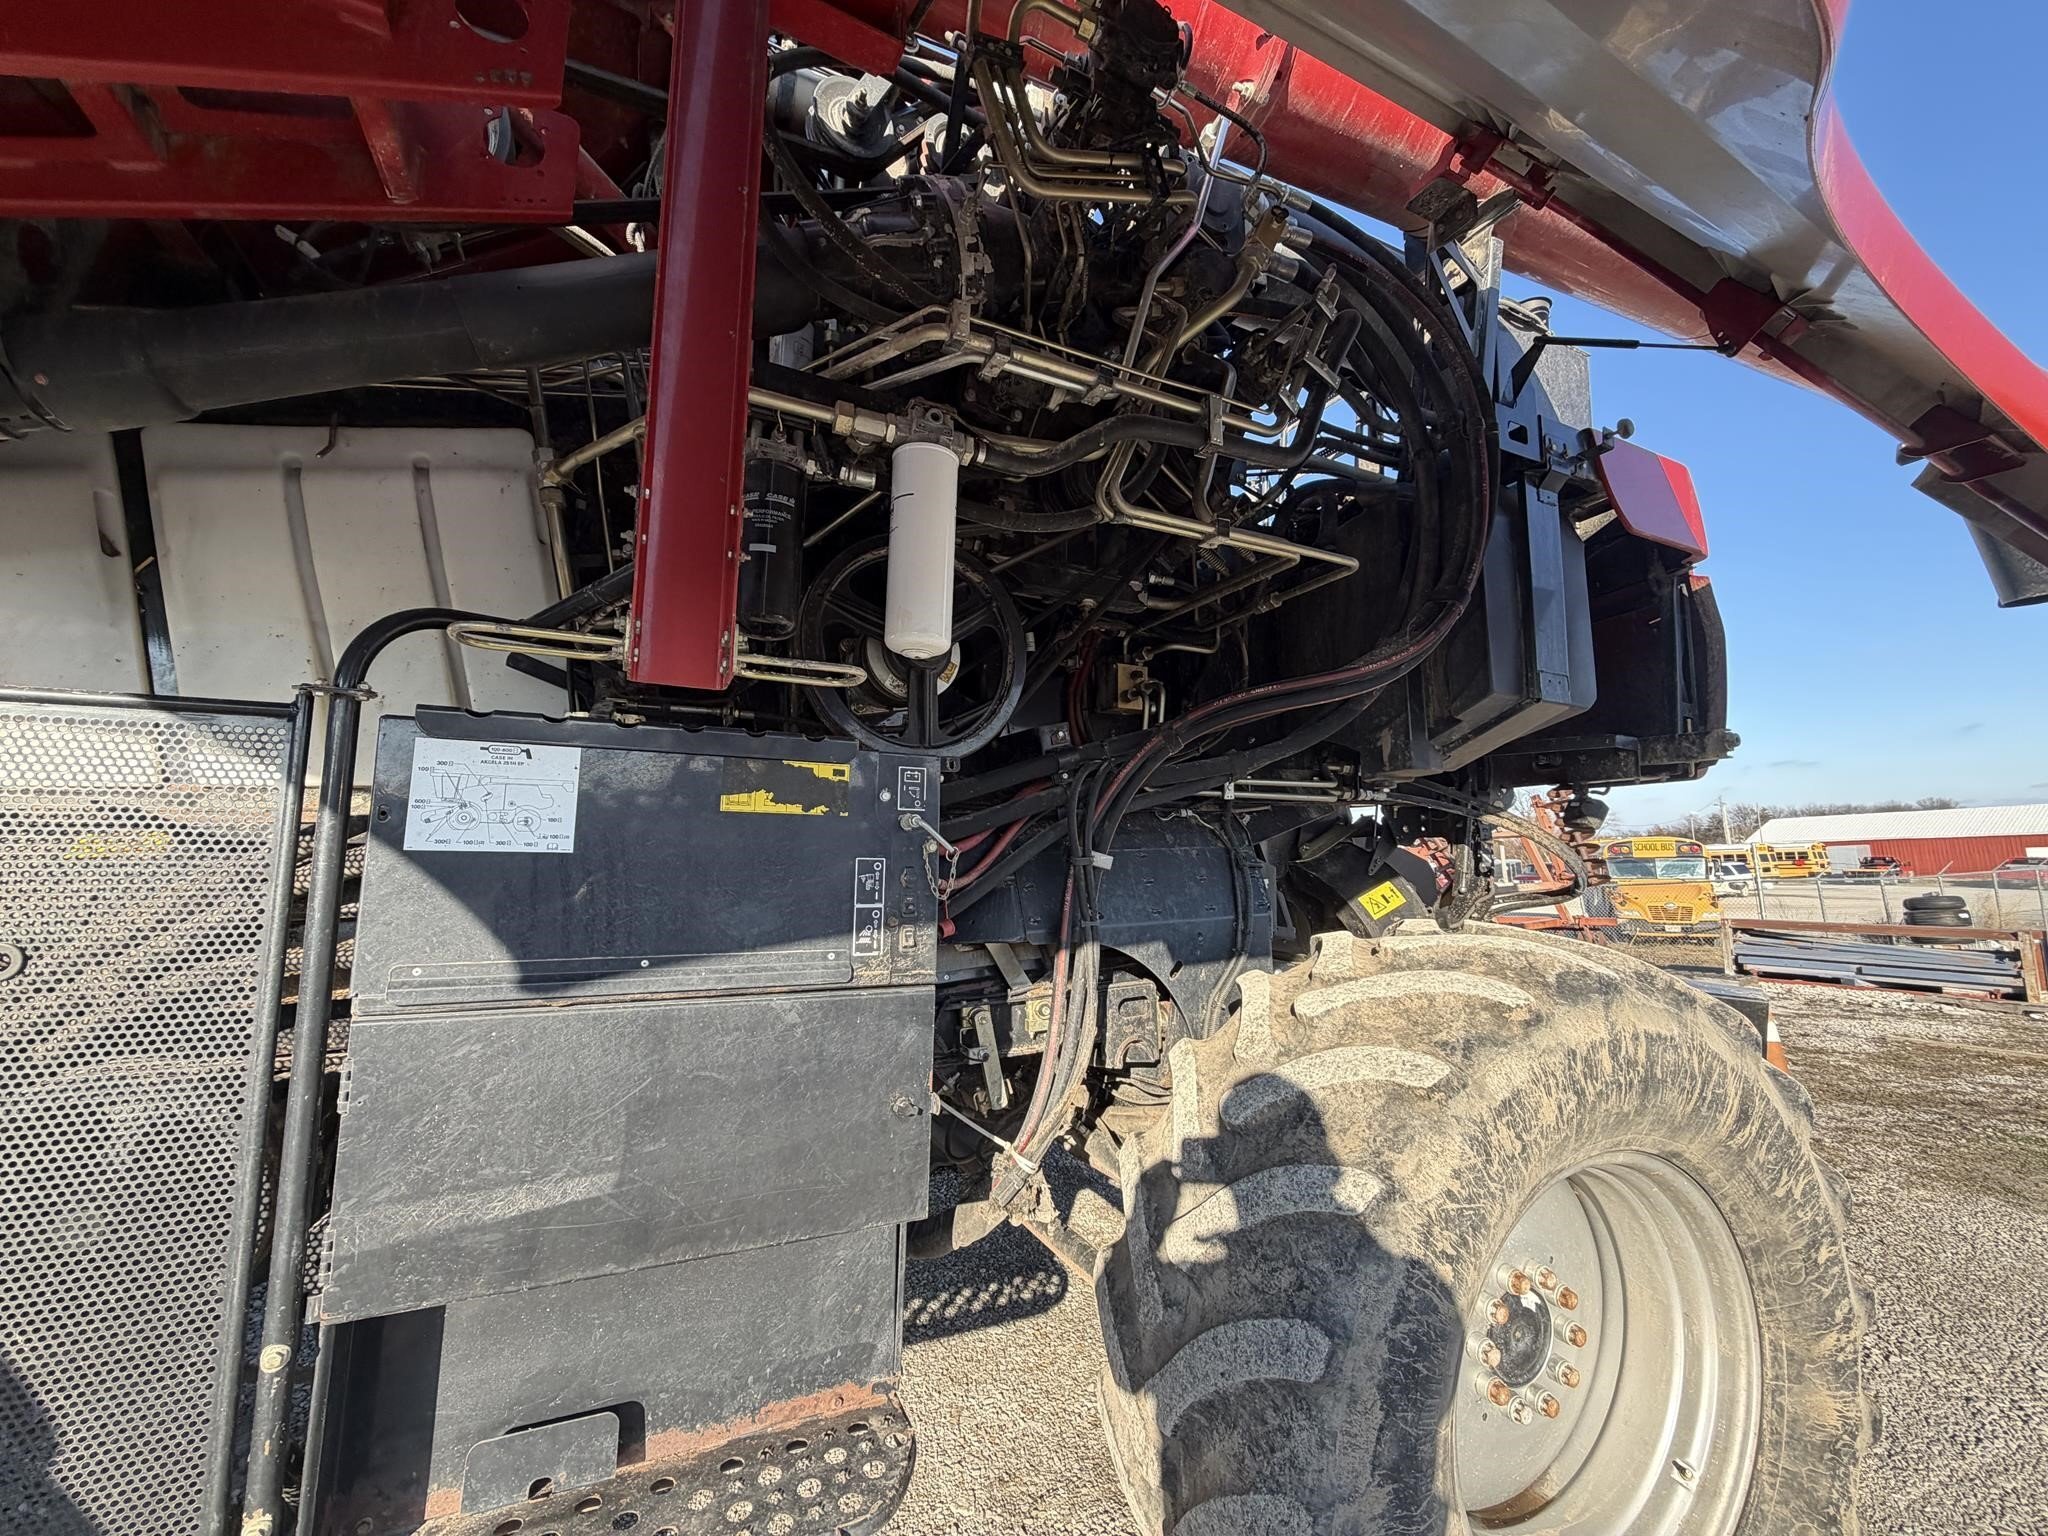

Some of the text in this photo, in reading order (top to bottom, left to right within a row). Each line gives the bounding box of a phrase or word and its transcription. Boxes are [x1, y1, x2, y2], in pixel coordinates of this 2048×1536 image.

[766, 492, 788, 502] CASE
[1634, 843, 1674, 851] SCHOOL BUS
